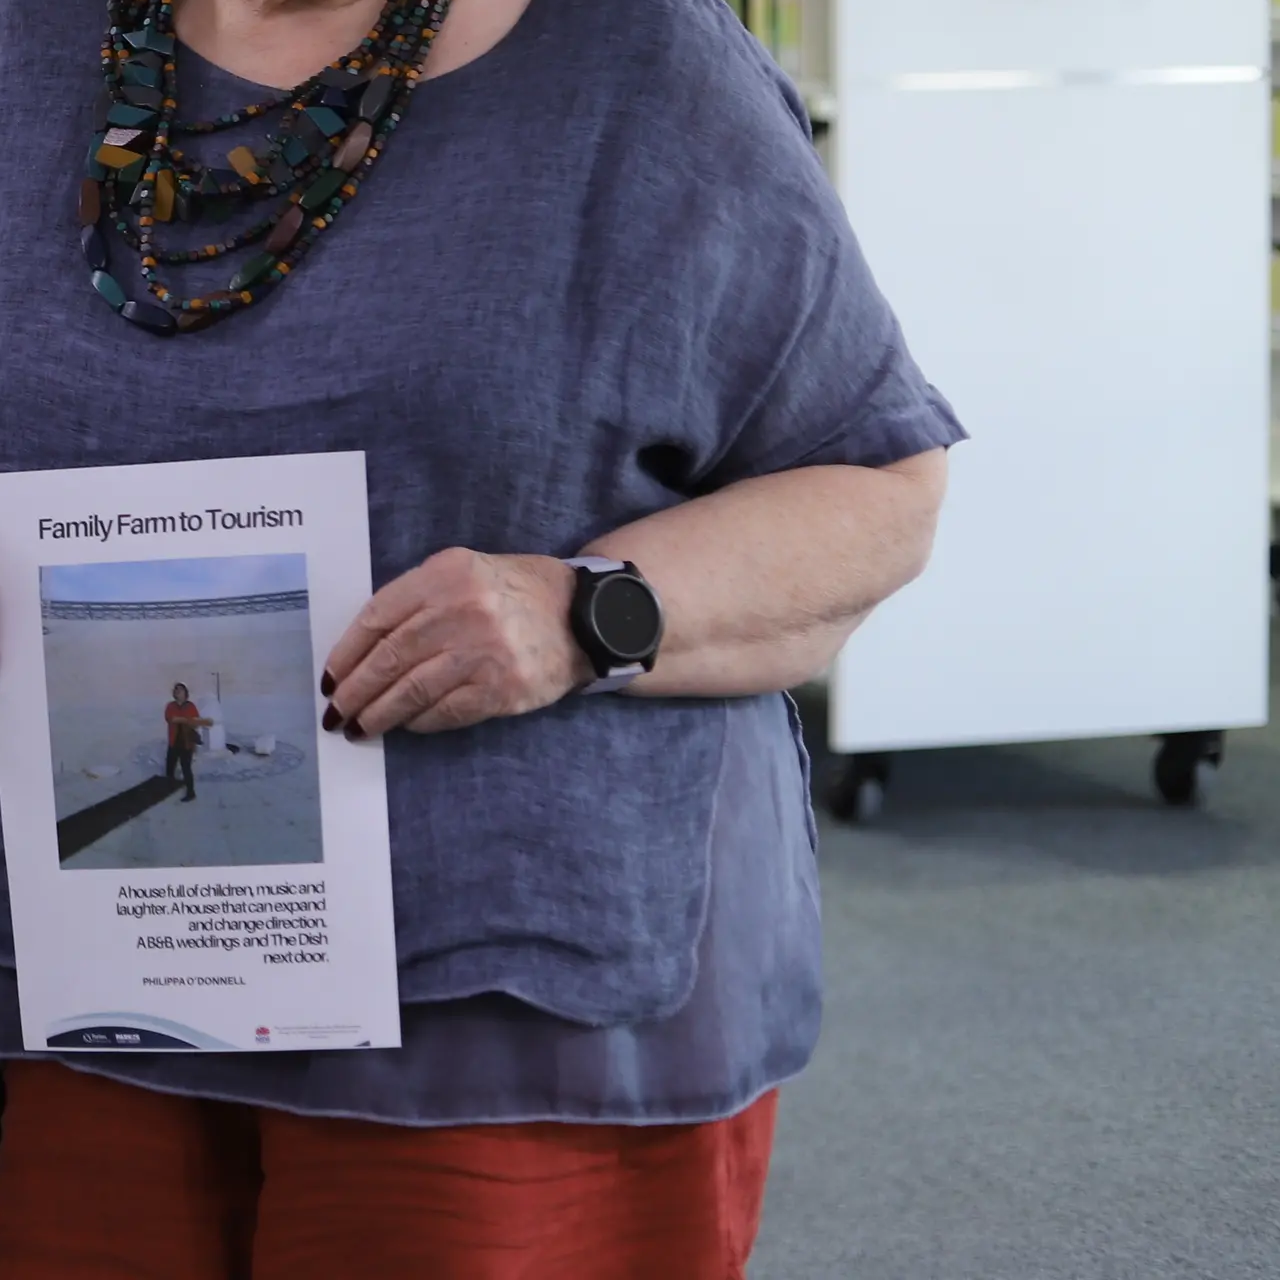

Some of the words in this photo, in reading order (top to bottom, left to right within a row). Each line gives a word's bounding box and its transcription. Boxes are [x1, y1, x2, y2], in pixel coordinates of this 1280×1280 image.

[38, 514, 114, 543] Family
[117, 513, 176, 536] Farm
[178, 511, 203, 532] to
[204, 505, 304, 531] Tourism
[118, 885, 128, 899] A
[128, 885, 166, 899] house
[167, 883, 186, 898] full
[186, 883, 199, 898] of
[200, 883, 254, 898] children,
[256, 880, 298, 896] music
[299, 880, 326, 895] and
[116, 901, 170, 919] laughter.
[171, 901, 181, 915] A
[181, 901, 221, 915] house
[221, 900, 247, 914] that
[248, 901, 273, 914] can
[274, 898, 327, 916] expand
[188, 918, 214, 932] and
[214, 917, 265, 934] change
[265, 915, 328, 930] direction.
[176, 934, 241, 952] weddings
[243, 933, 269, 948] and
[270, 933, 298, 947] The
[298, 932, 329, 946] Dish
[263, 950, 294, 964] next
[294, 949, 330, 964] door.
[142, 976, 186, 987] PHILIPPA
[187, 975, 247, 986] O'DONNELL
